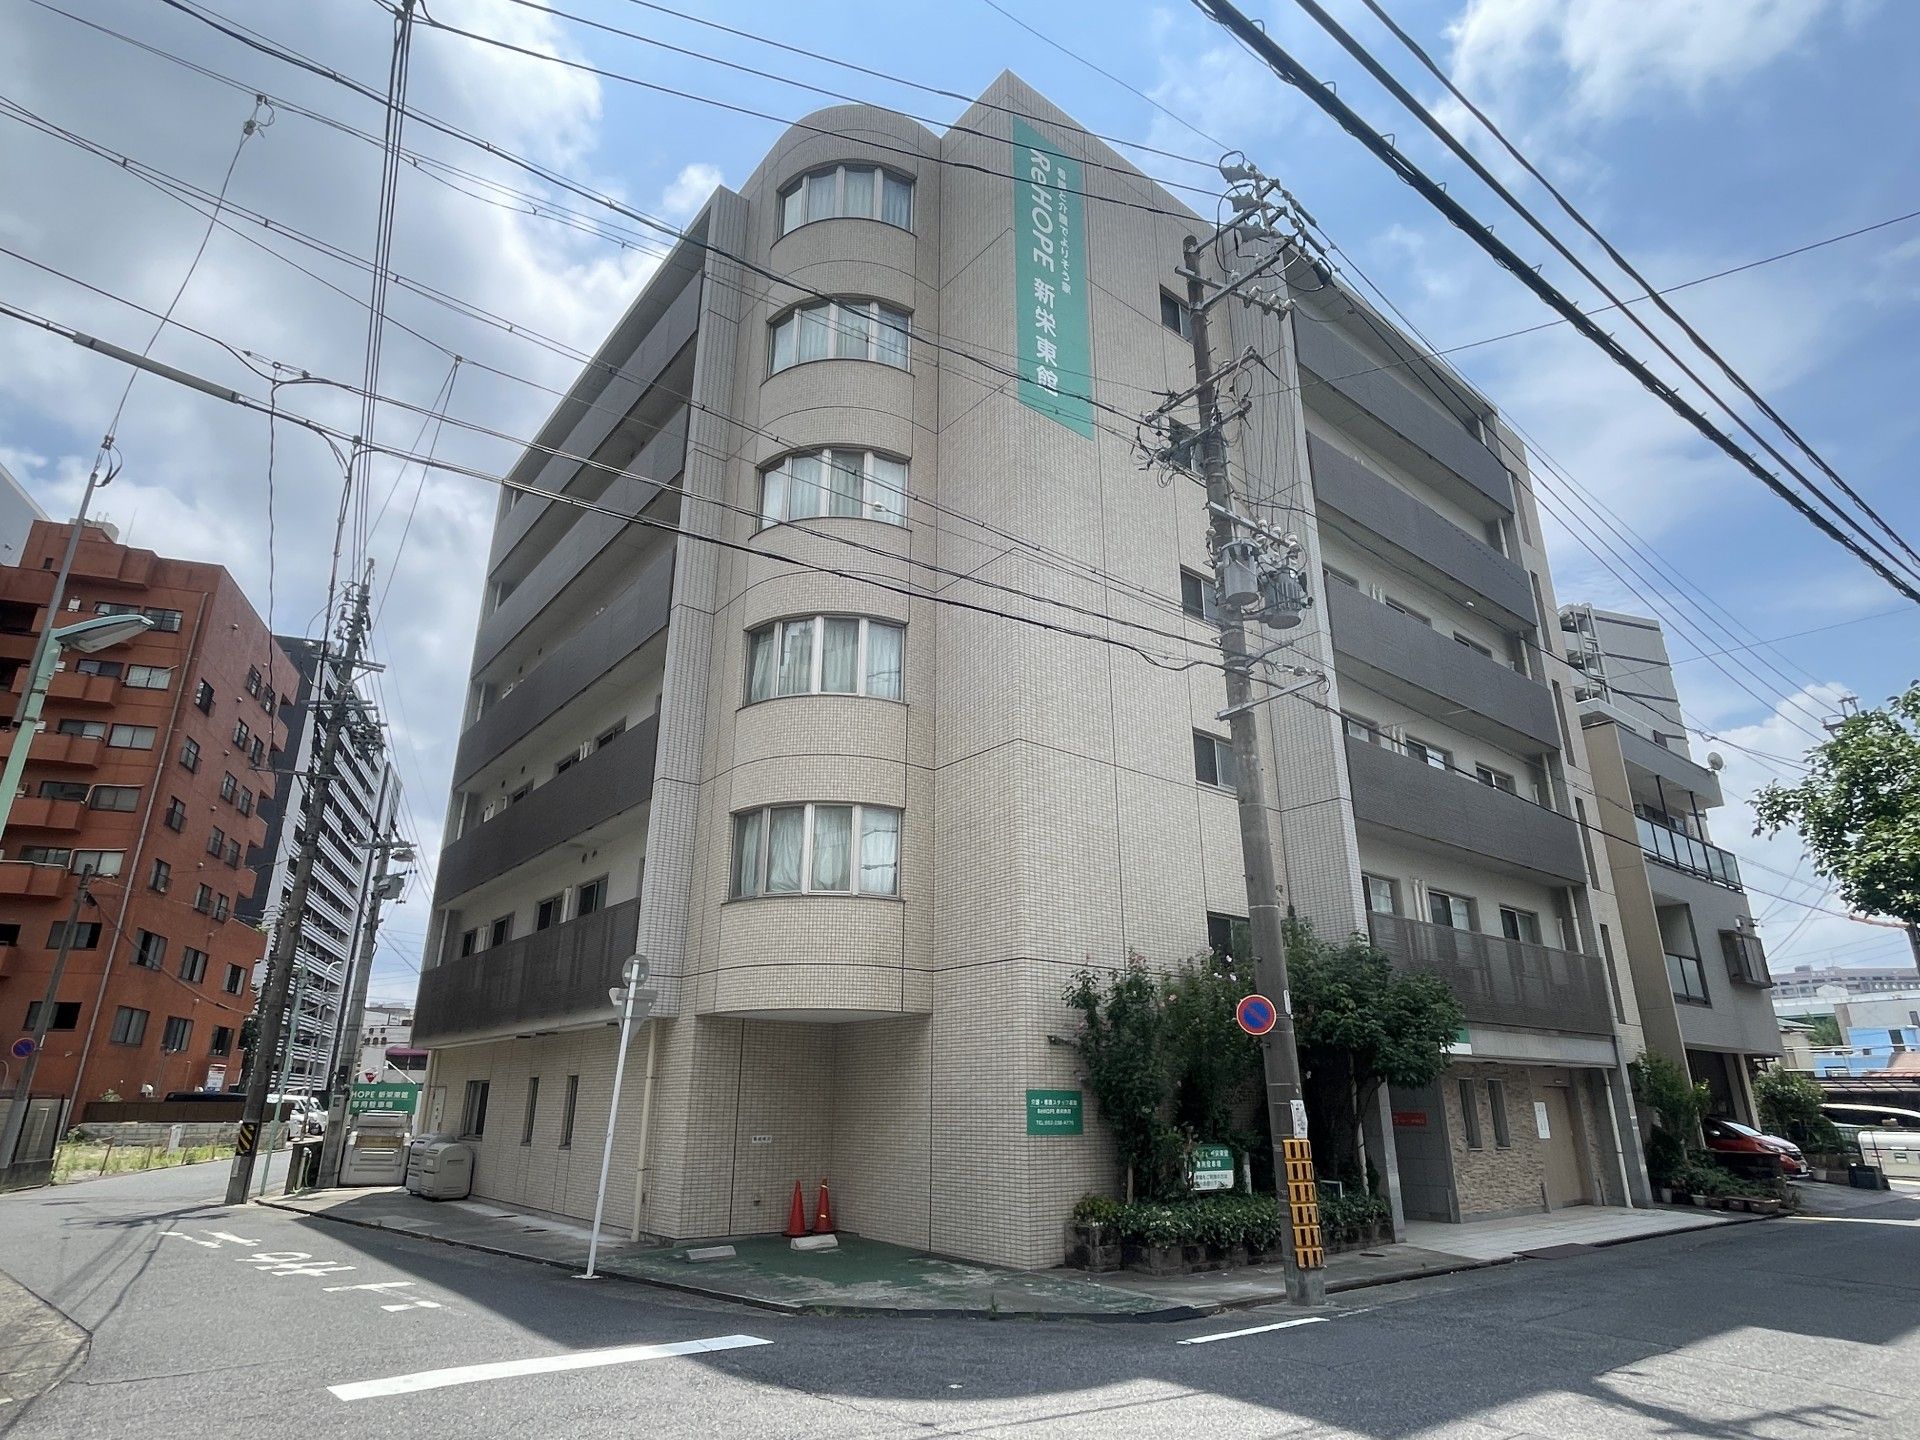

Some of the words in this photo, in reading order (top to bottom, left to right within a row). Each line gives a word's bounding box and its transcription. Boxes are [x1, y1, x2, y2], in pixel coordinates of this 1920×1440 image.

[1030, 148, 1055, 273] ReHOPE
[1034, 277, 1059, 397] 新栄東館
